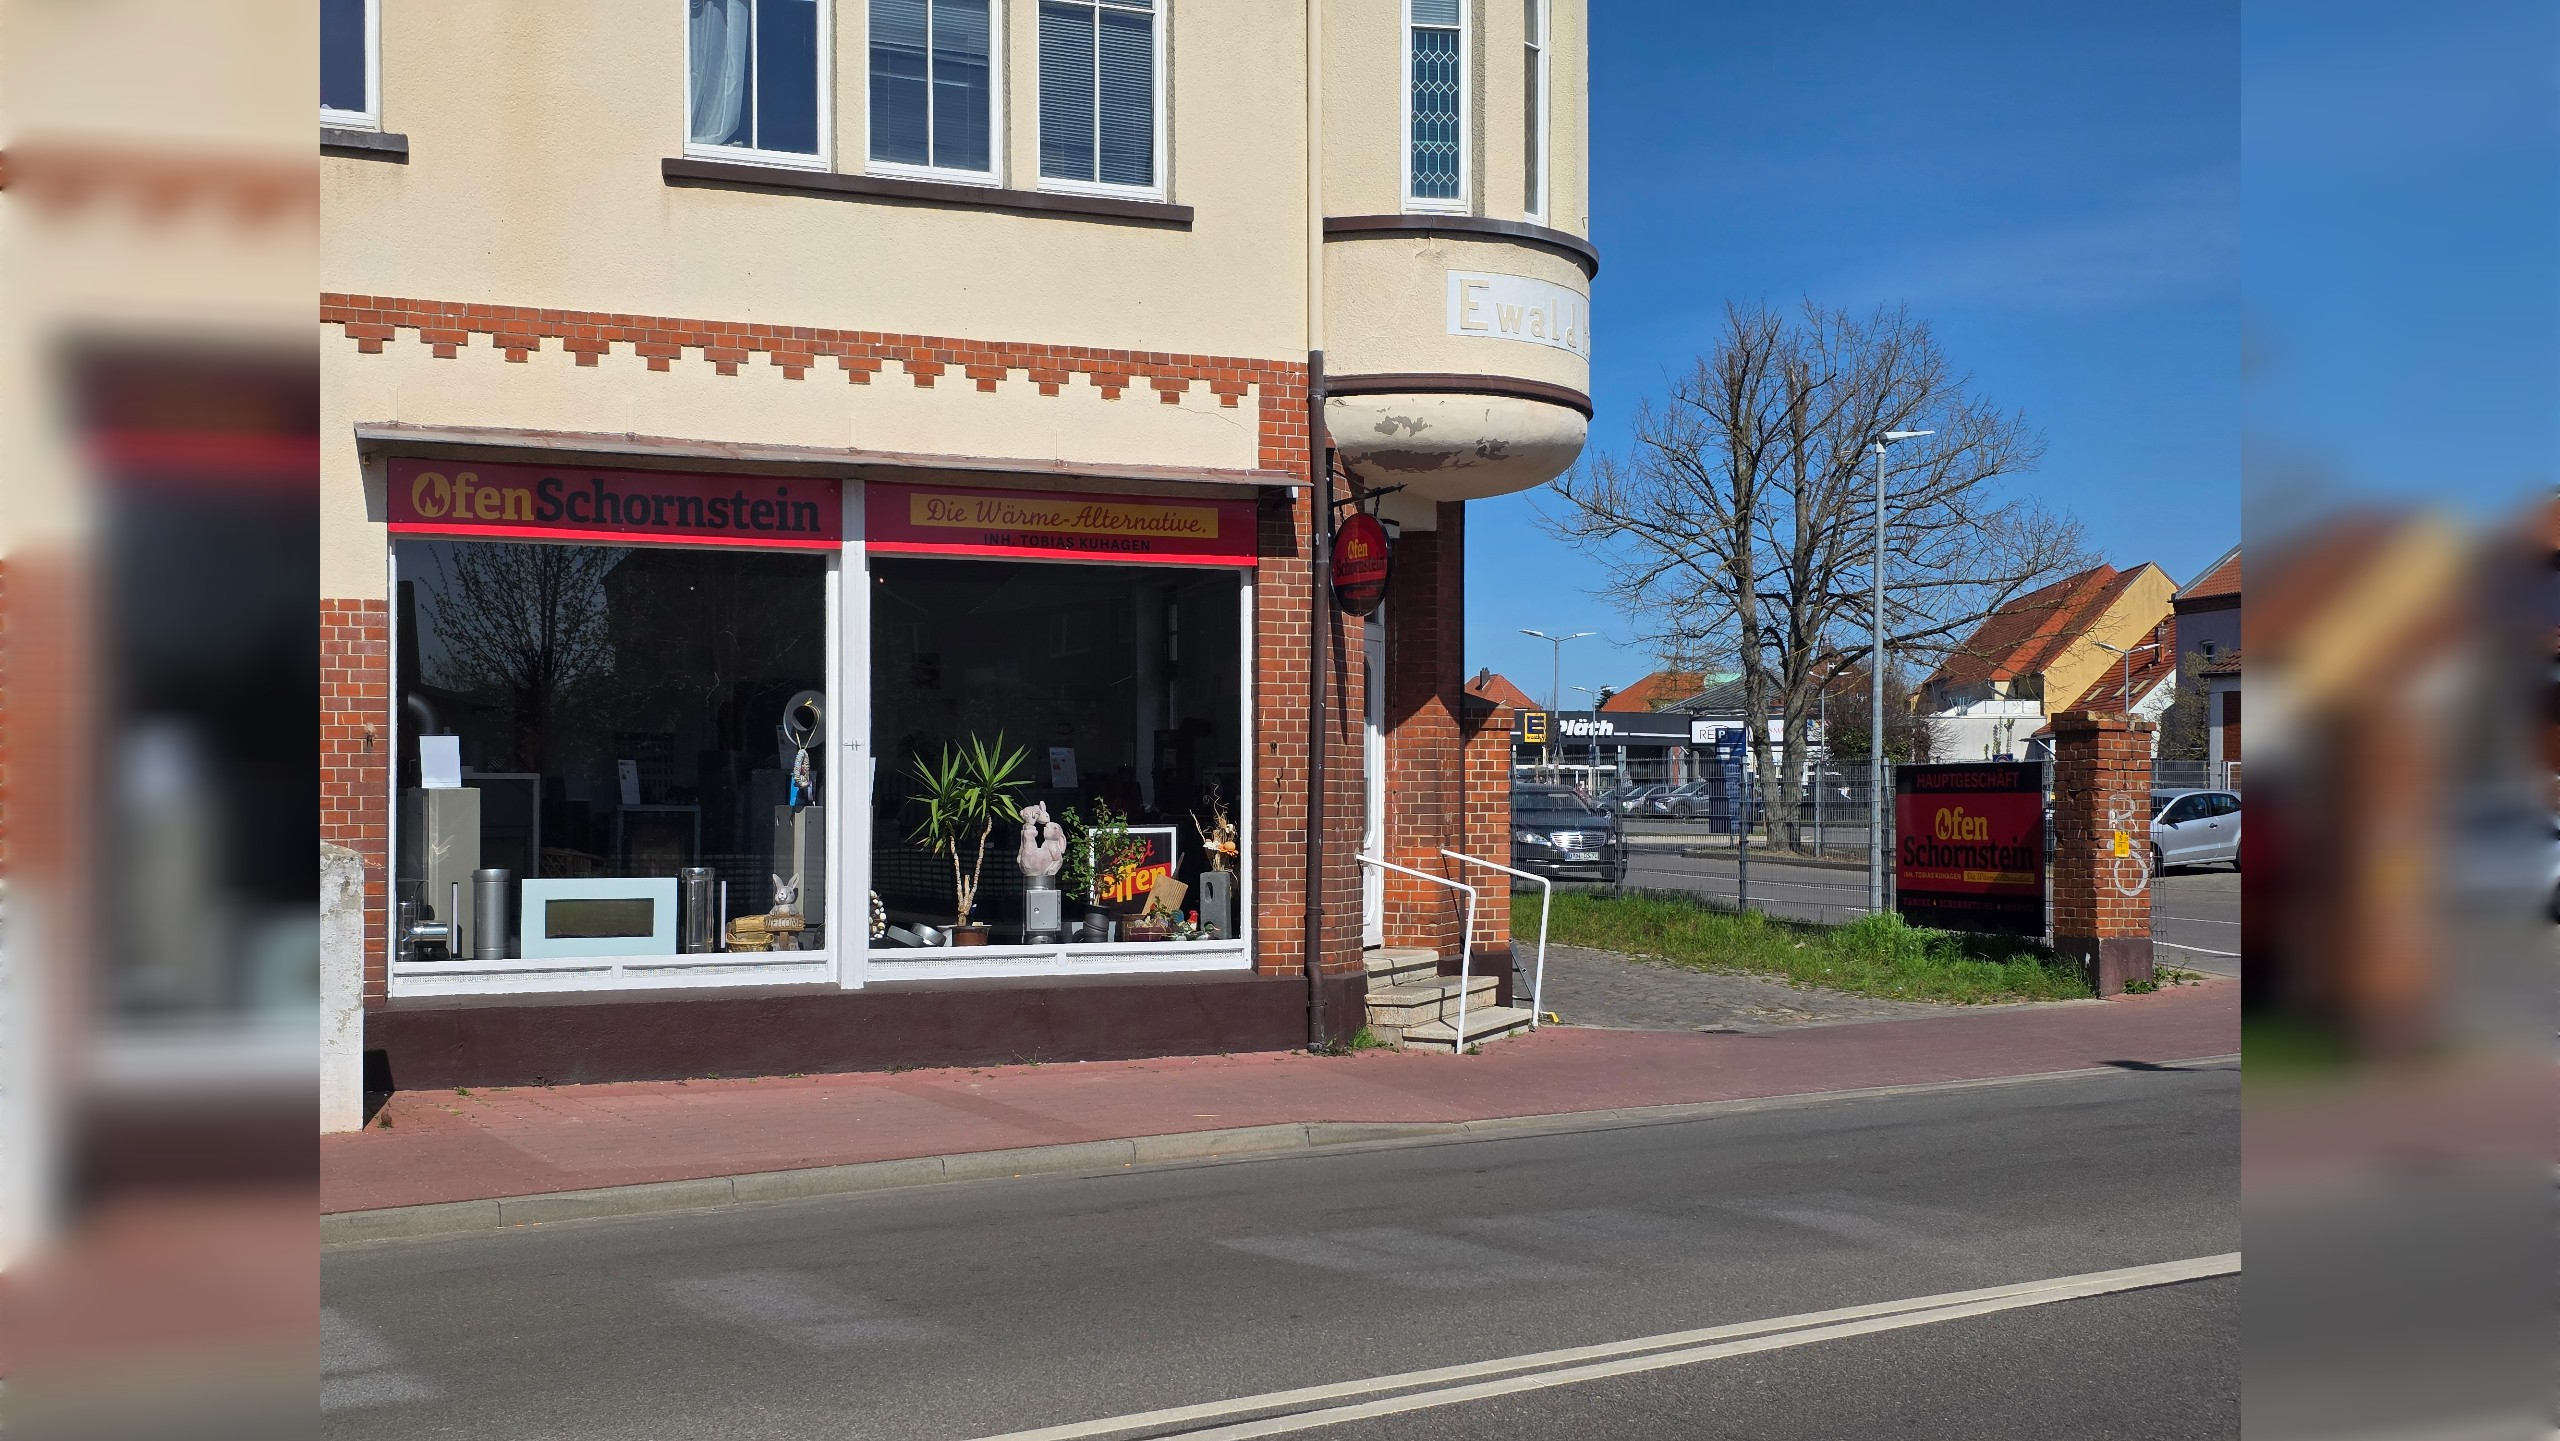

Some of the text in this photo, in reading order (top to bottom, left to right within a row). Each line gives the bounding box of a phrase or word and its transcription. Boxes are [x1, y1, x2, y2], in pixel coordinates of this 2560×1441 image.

[926, 498, 968, 523] Die
[983, 533, 1151, 552] INH. TOBIAS KUHAGEN
[1347, 539, 1369, 560] Ofen
[1336, 552, 1384, 578] Schornstein
[1916, 769, 2020, 789] HAUPTGESCHÄFT
[1935, 806, 1989, 841] Ofen
[1903, 836, 2035, 870] Schornstein
[765, 917, 803, 928] WELCOME
